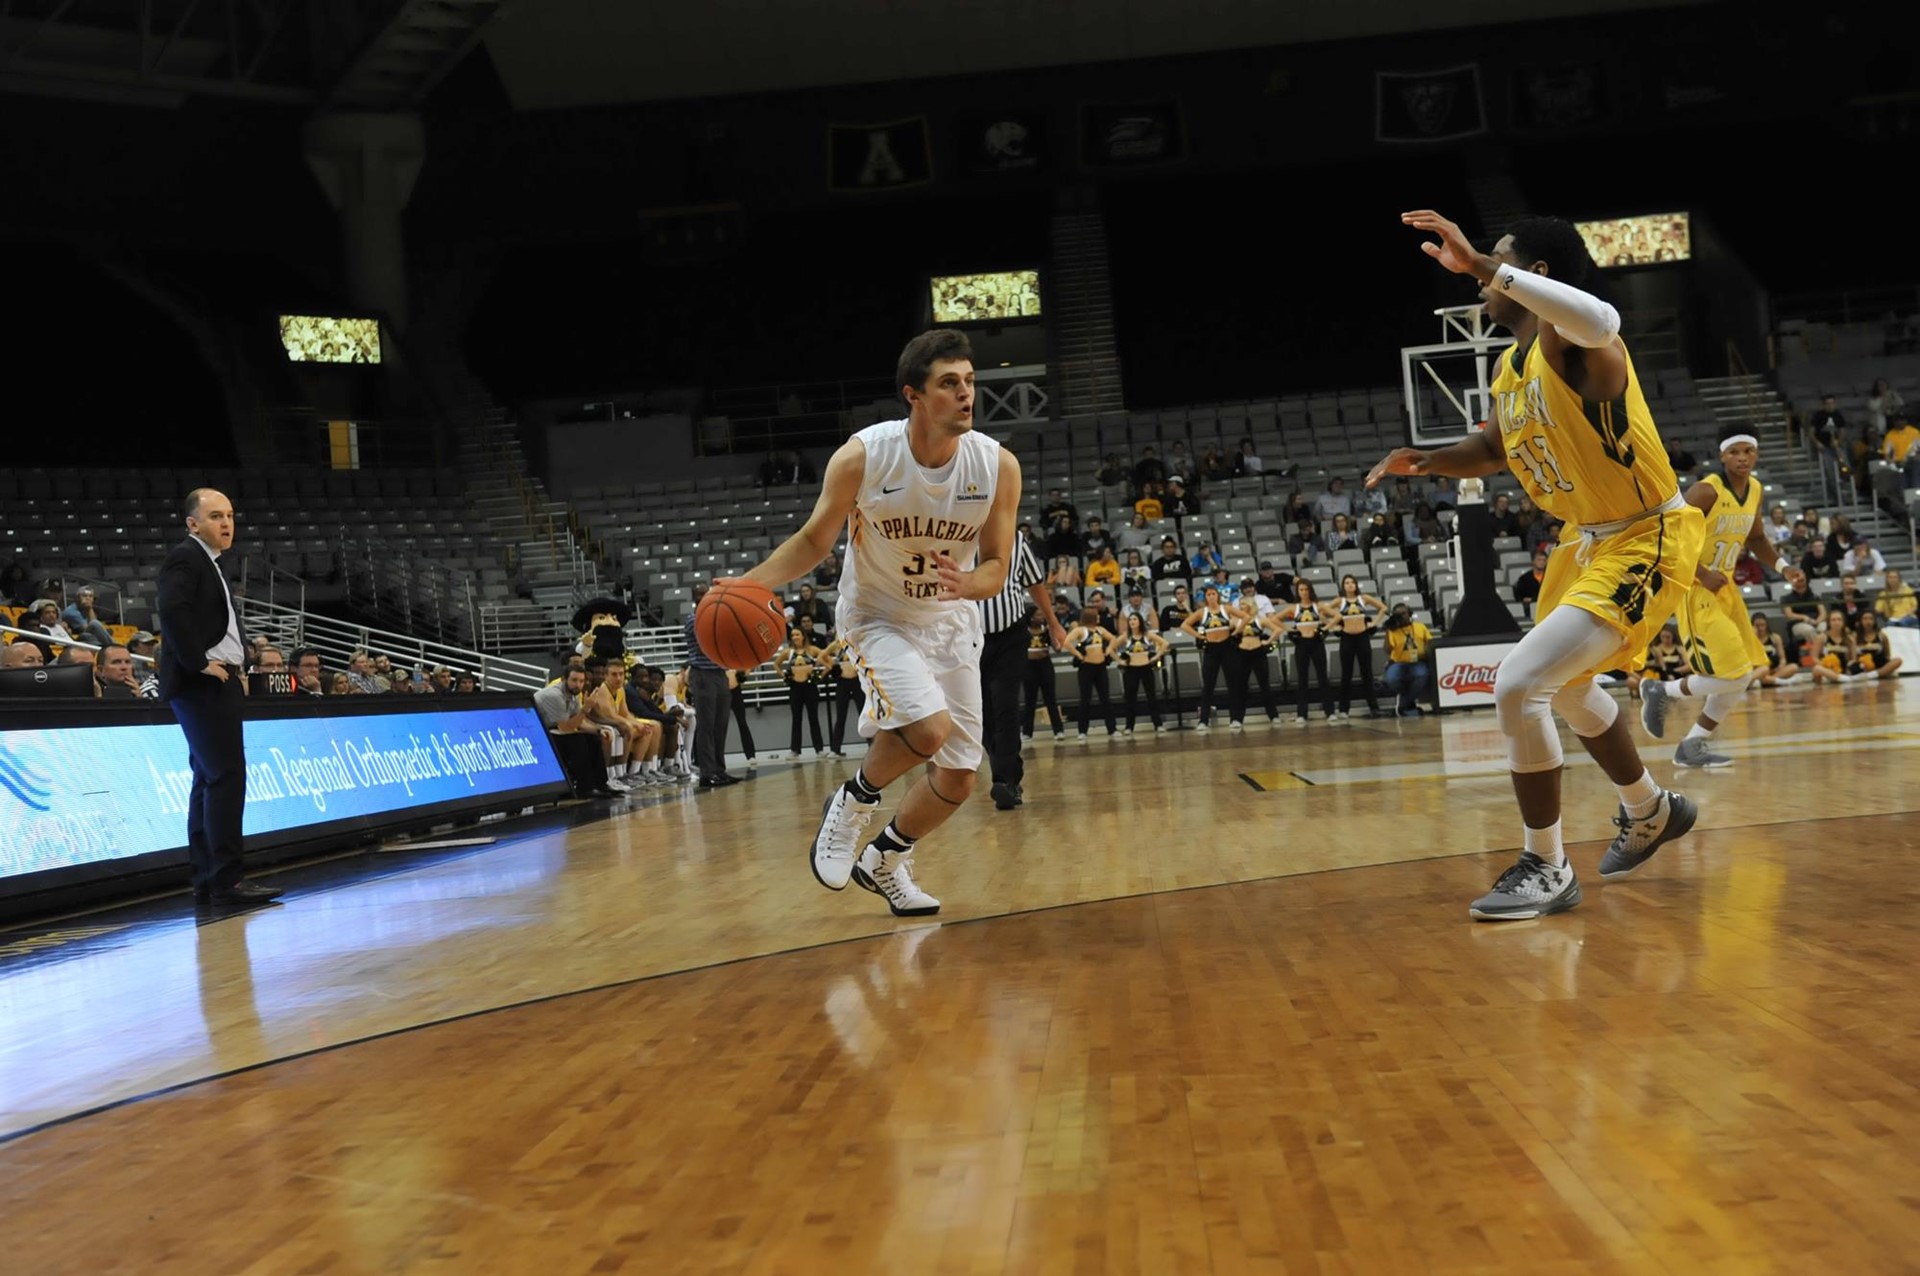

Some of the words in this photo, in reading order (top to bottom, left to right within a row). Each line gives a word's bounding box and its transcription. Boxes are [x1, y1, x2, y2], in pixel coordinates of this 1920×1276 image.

[858, 130, 904, 183] A
[904, 580, 947, 599] STAT
[269, 739, 357, 813] Regional
[345, 733, 441, 797] Orthopaedic
[430, 732, 455, 777] &
[444, 732, 493, 788] Sports
[480, 727, 538, 770] Medicine
